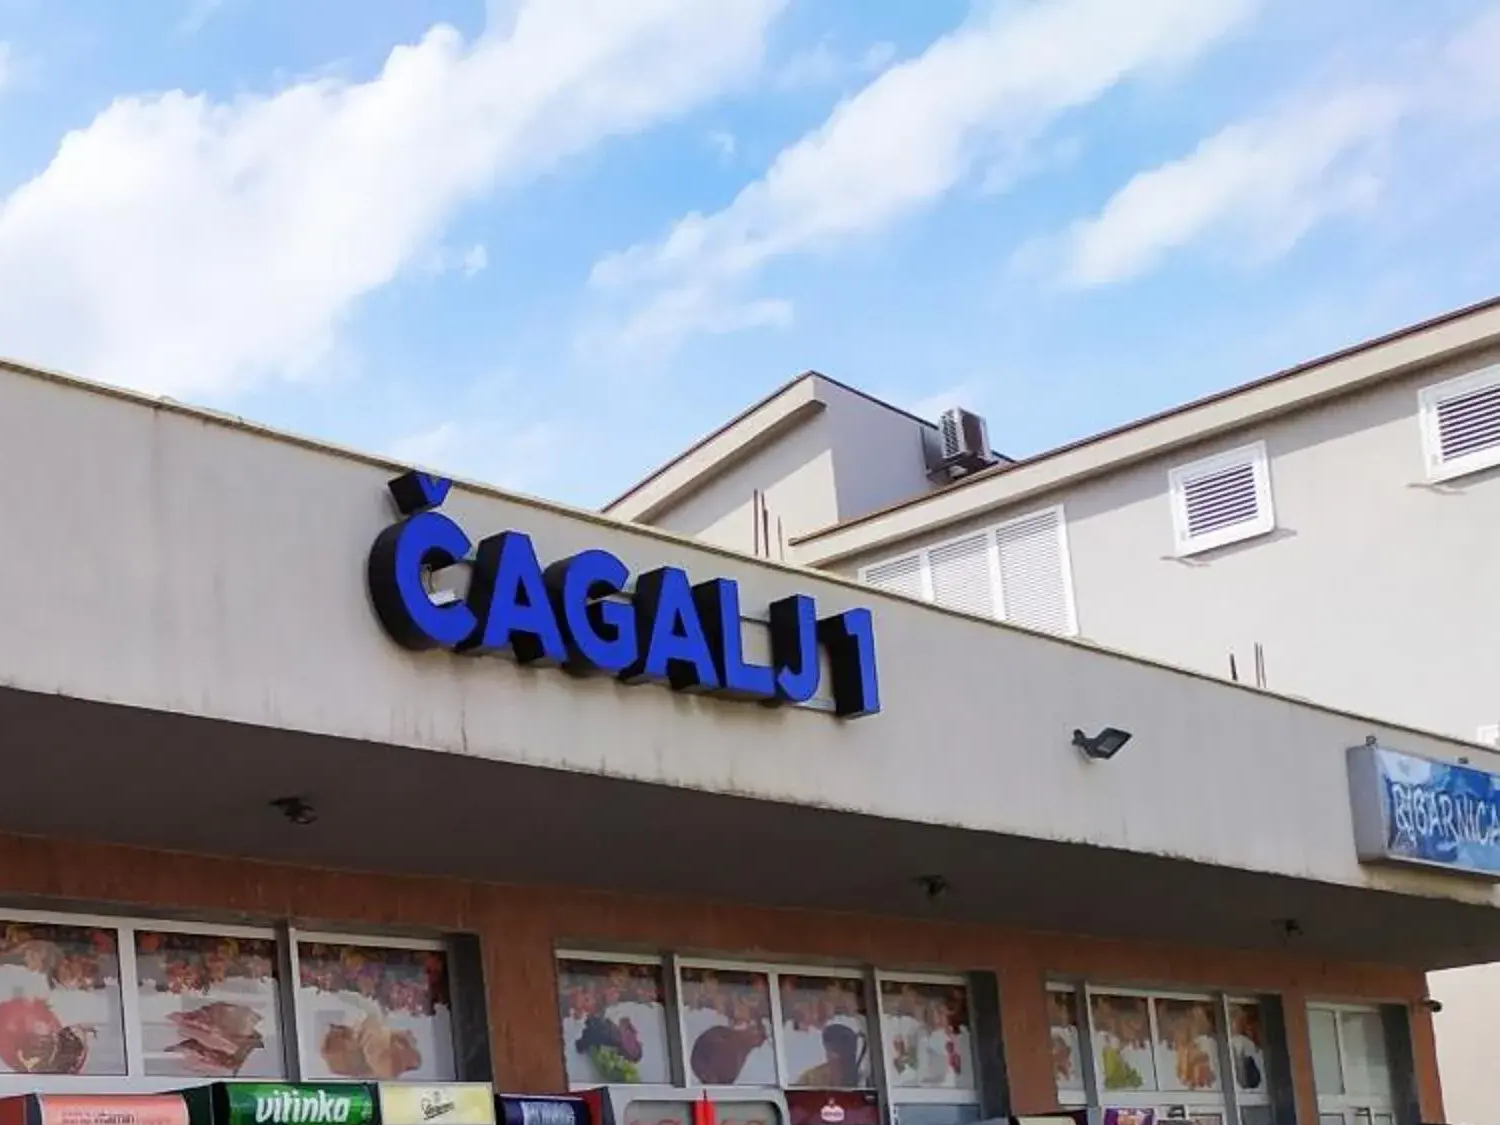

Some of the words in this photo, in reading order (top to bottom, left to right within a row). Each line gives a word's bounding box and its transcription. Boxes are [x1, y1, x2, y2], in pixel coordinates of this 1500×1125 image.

[372, 470, 821, 702] ČAGALJ
[830, 607, 881, 718] 1
[255, 1084, 351, 1123] vitinka
